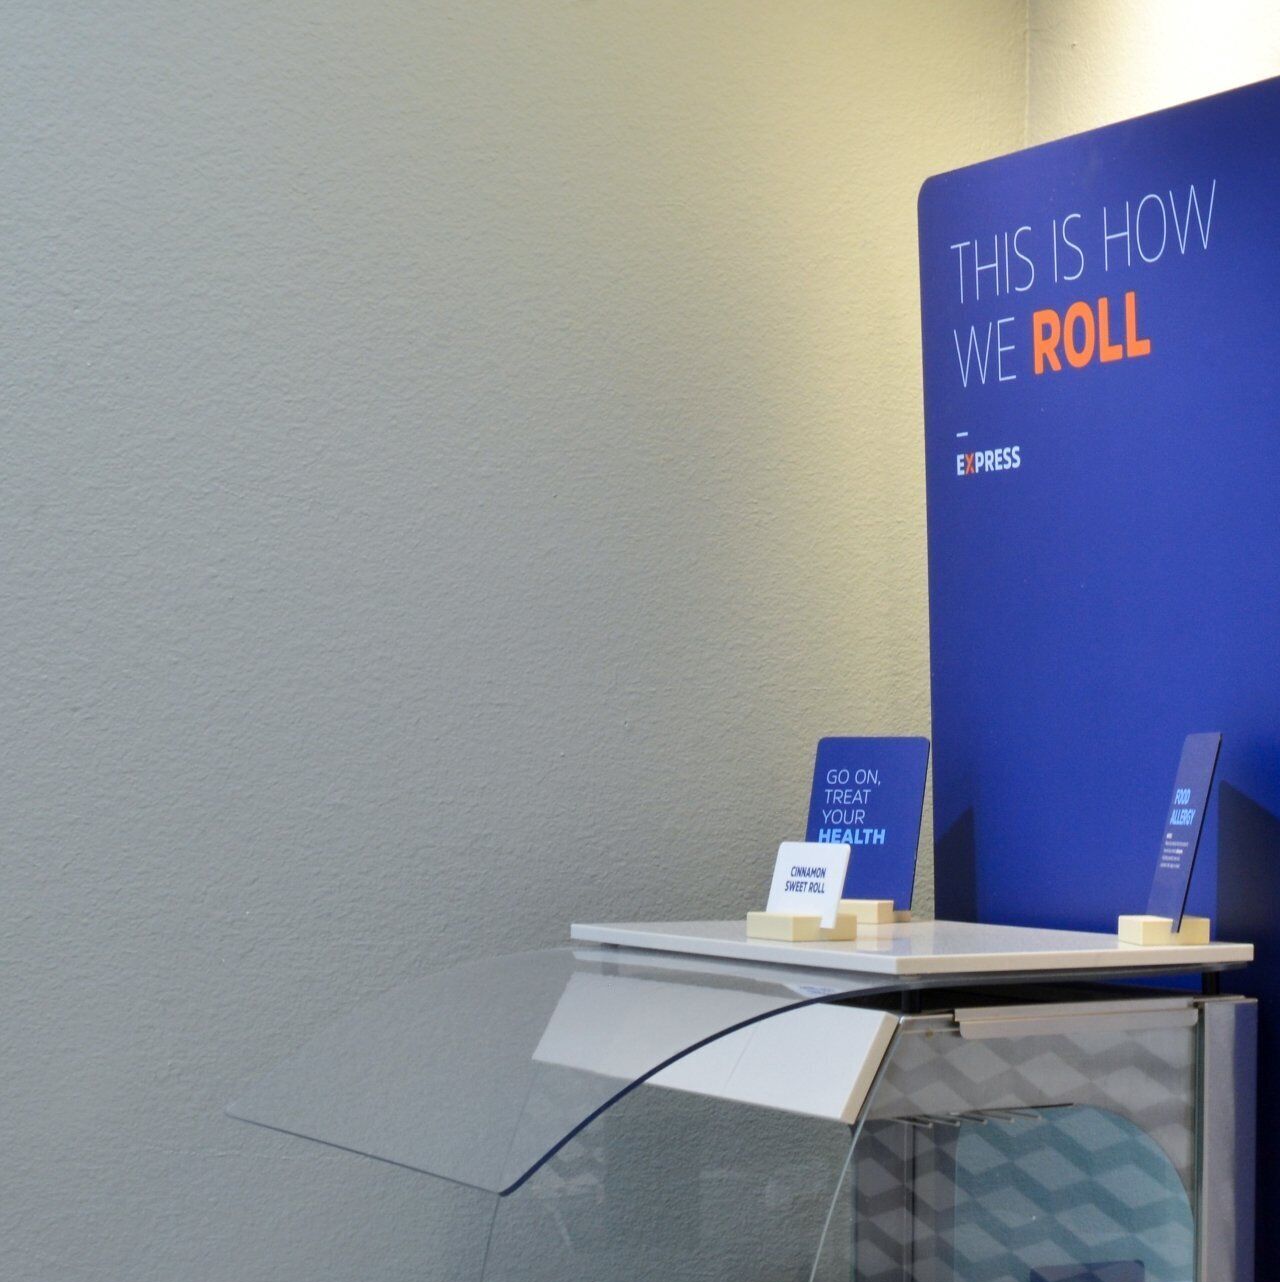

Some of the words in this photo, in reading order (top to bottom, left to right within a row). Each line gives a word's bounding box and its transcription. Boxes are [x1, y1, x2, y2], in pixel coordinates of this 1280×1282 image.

[951, 225, 1035, 303] THIS
[1053, 213, 1085, 283] IS
[1103, 179, 1216, 271] HOW
[954, 317, 1017, 388] WE
[1033, 291, 1151, 375] ROLL
[956, 446, 1021, 476] EXPRESS
[826, 769, 849, 785] GO
[854, 769, 881, 786] ON,
[825, 788, 871, 804] TREAT
[1173, 788, 1191, 805] FOOD
[822, 808, 865, 824] YOUR
[1169, 808, 1196, 825] ALLERGY
[818, 828, 886, 845] HEALTH
[790, 866, 826, 878] CINNAMON
[785, 880, 807, 892] SWEET
[808, 881, 825, 893] ROLL
